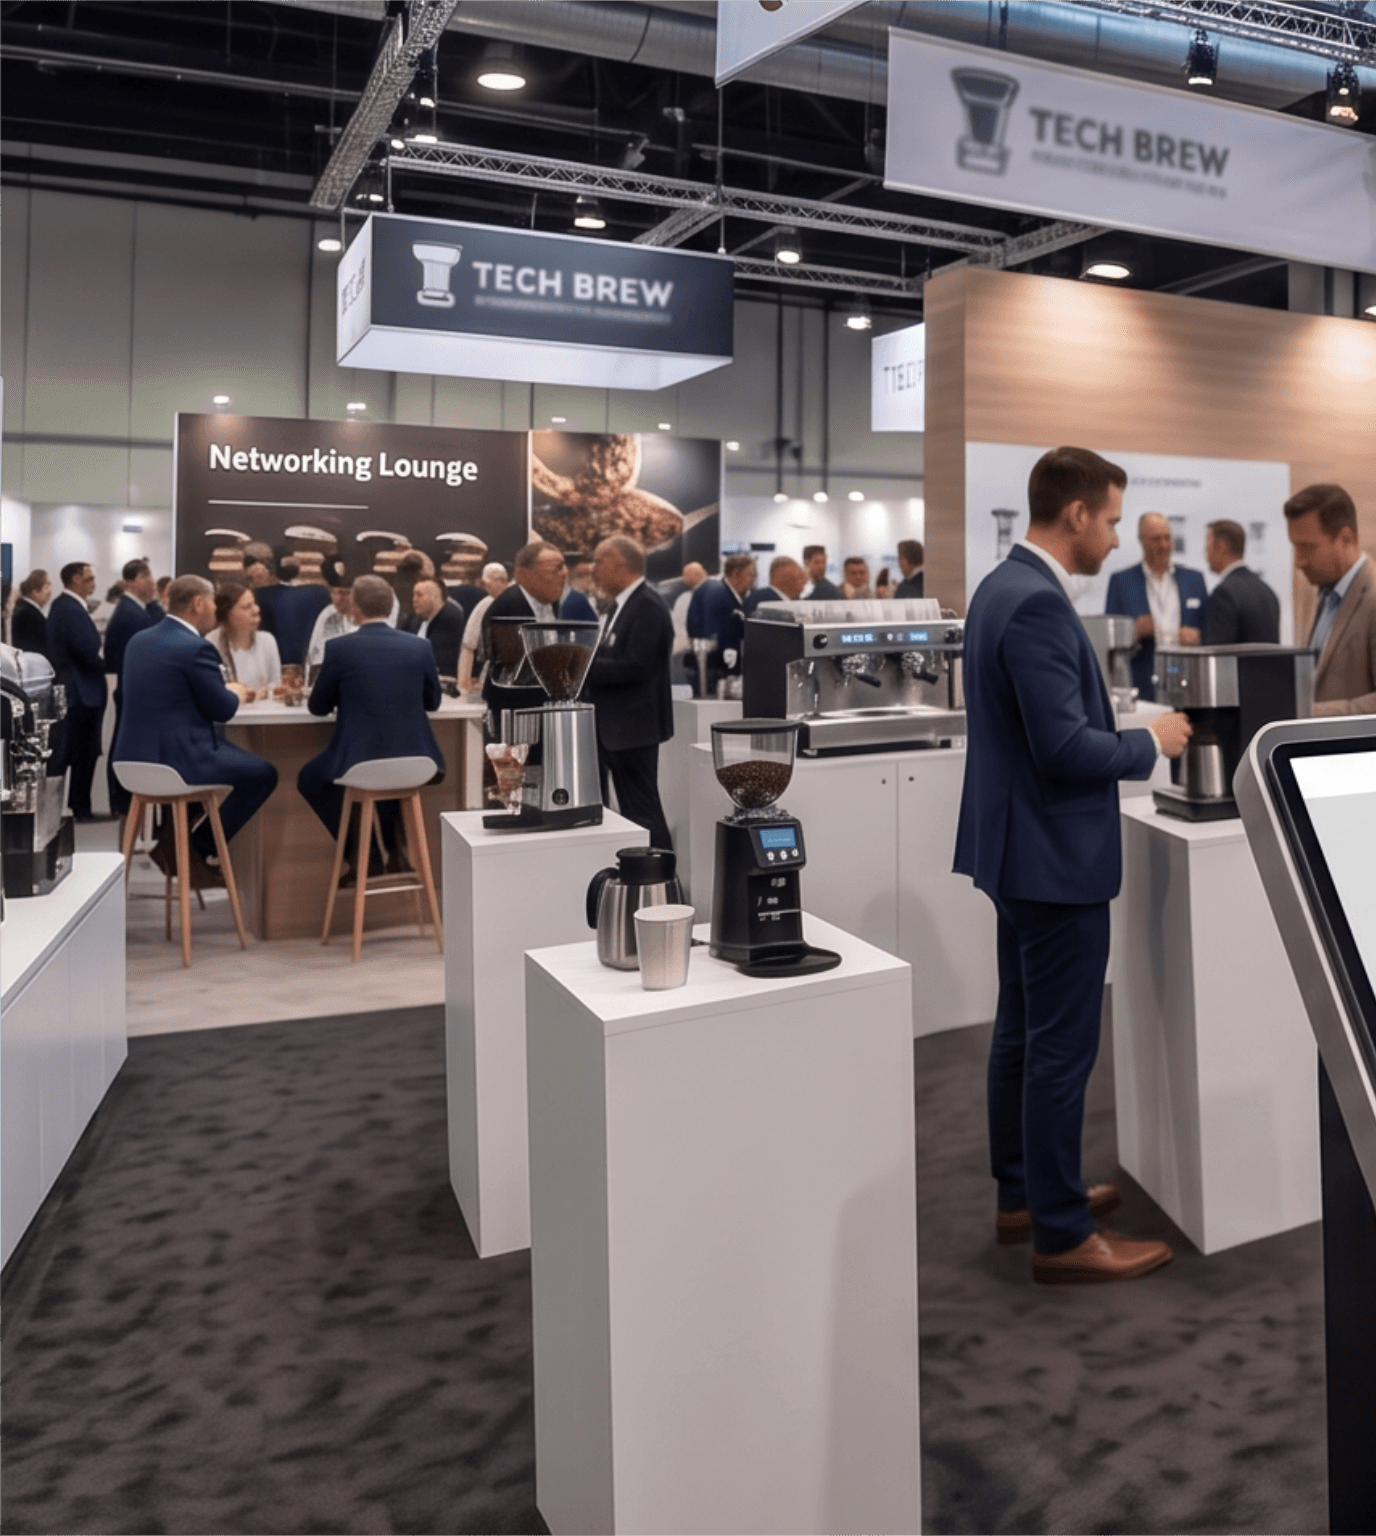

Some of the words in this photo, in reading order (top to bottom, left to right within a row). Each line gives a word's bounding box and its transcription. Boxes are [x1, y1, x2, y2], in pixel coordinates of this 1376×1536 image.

[1028, 106, 1124, 157] TECH
[1133, 128, 1231, 177] BREW
[472, 260, 562, 297] TECH
[573, 272, 674, 308] BREW
[208, 443, 373, 482] Networking
[379, 452, 479, 487] Lounge
